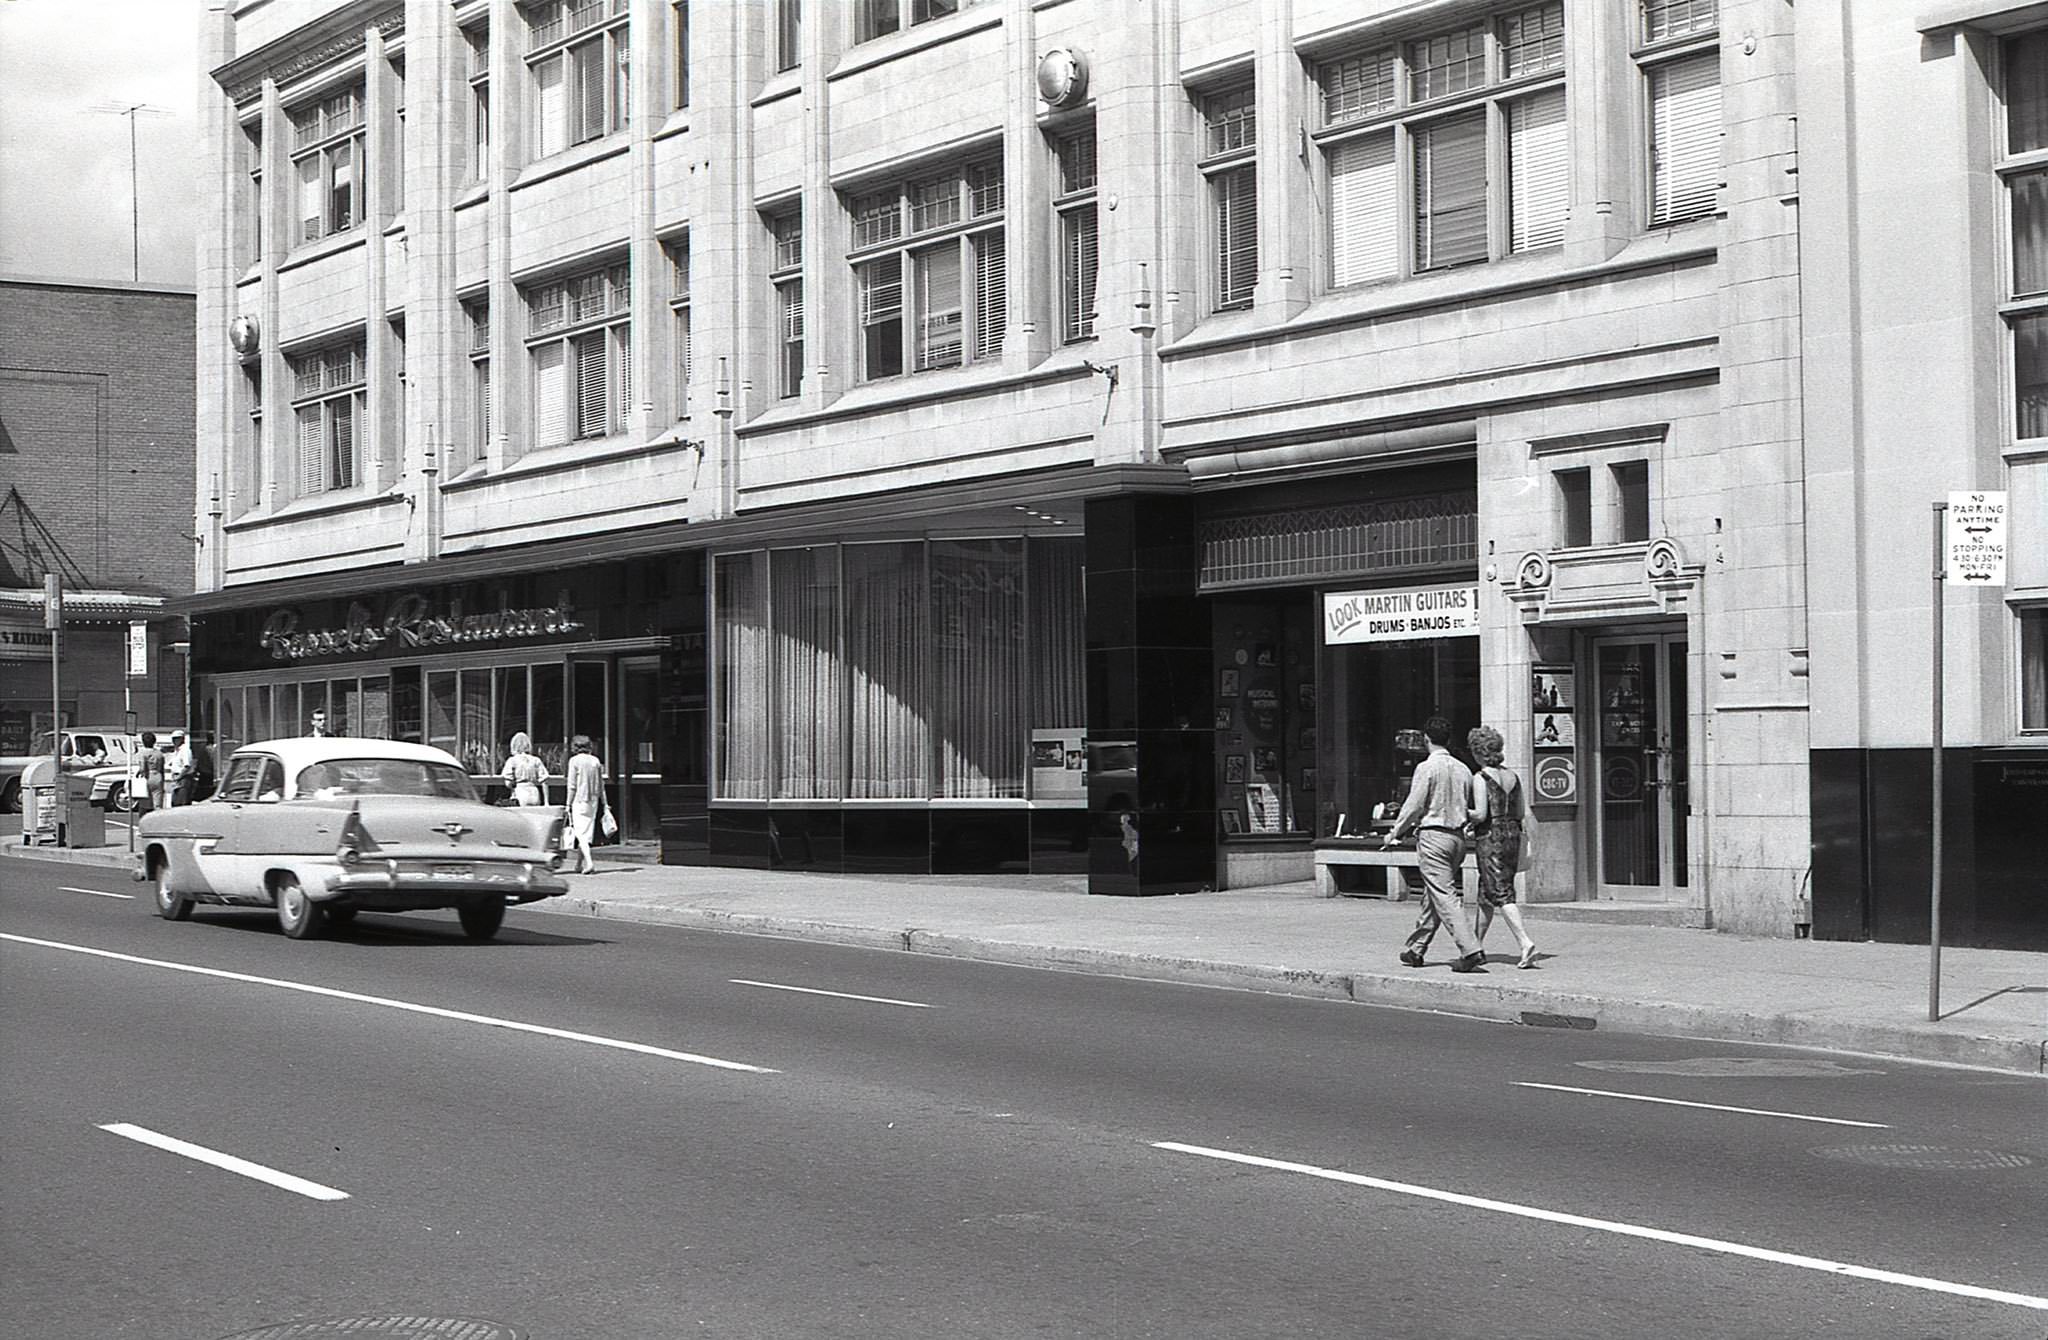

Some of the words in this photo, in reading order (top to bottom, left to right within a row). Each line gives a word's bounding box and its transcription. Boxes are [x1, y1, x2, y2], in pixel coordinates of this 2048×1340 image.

[1971, 494, 1985, 503] NO
[1953, 504, 2004, 514] PARKING
[1956, 516, 2001, 524] ANYTIME
[1972, 535, 1985, 544] NO
[1952, 544, 2004, 553] STOPPING
[1364, 594, 1412, 616] MARTIN
[1416, 590, 1468, 612] GUITARS
[383, 589, 584, 648] Restaurant
[1328, 597, 1362, 632] LOOK
[1369, 619, 1405, 635] DRUMS
[1411, 616, 1451, 632] BANJOS
[1535, 756, 1576, 799] 6
[1542, 776, 1568, 790] CBC-TV
